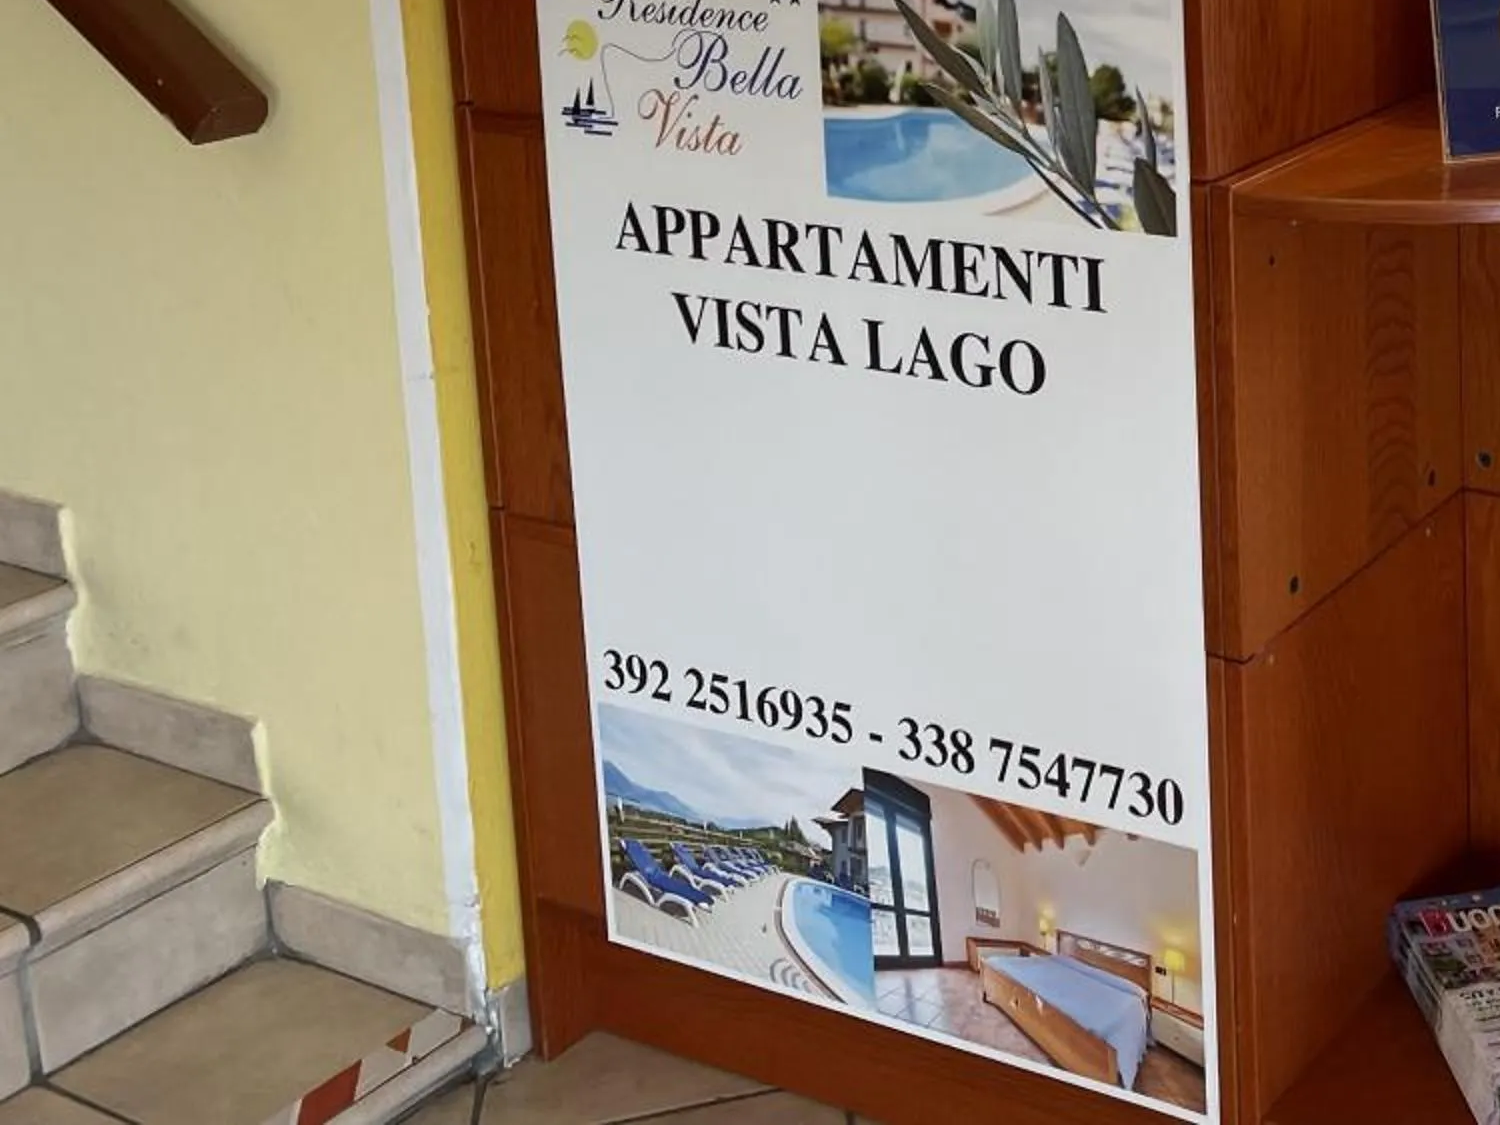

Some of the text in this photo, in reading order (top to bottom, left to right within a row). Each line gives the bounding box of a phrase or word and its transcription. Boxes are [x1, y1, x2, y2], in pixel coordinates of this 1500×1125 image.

[672, 29, 804, 101] Bella
[636, 88, 745, 157] Vista
[615, 201, 1109, 315] APPARTAMENTI
[670, 291, 1047, 396] VISTA LAGO
[602, 649, 673, 702] 392
[684, 667, 854, 744] 2516935
[898, 716, 976, 775] 338
[988, 738, 1185, 827] 7547730
